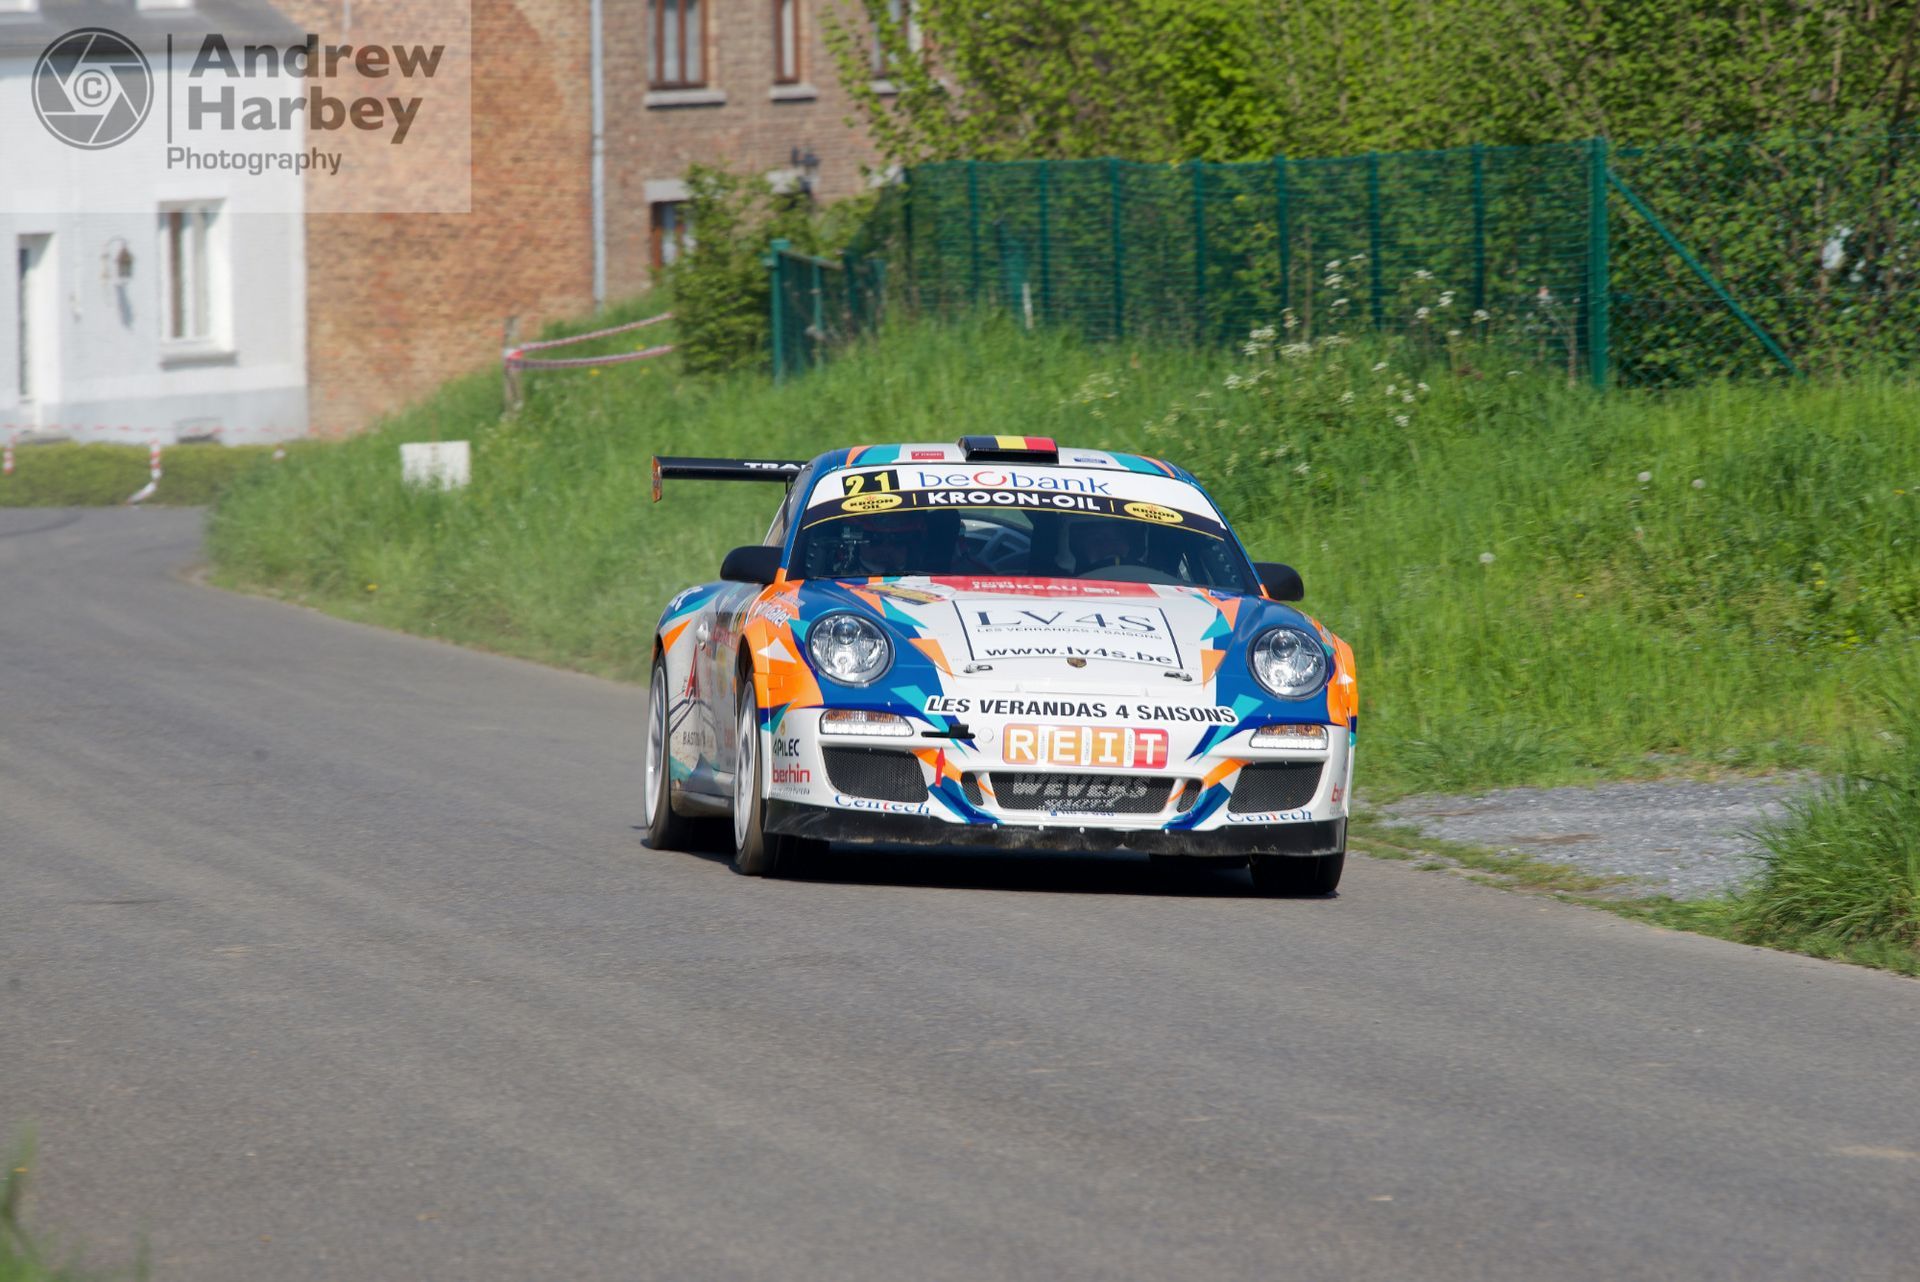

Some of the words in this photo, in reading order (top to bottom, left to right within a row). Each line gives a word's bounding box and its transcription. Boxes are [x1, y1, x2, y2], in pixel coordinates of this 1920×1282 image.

[845, 472, 892, 495] 21
[928, 491, 1100, 511] KROON-OIL
[975, 610, 1156, 633] LV4S
[985, 646, 1173, 664] www.lv4s.be
[927, 696, 971, 714] LES
[979, 699, 1107, 718] VERANDAS
[1116, 704, 1131, 719] 4
[1138, 703, 1237, 724] SAISONS
[1009, 728, 1163, 765] REIT
[772, 763, 811, 783] berhin
[834, 794, 930, 815] Centech
[1226, 809, 1313, 823] Centech
